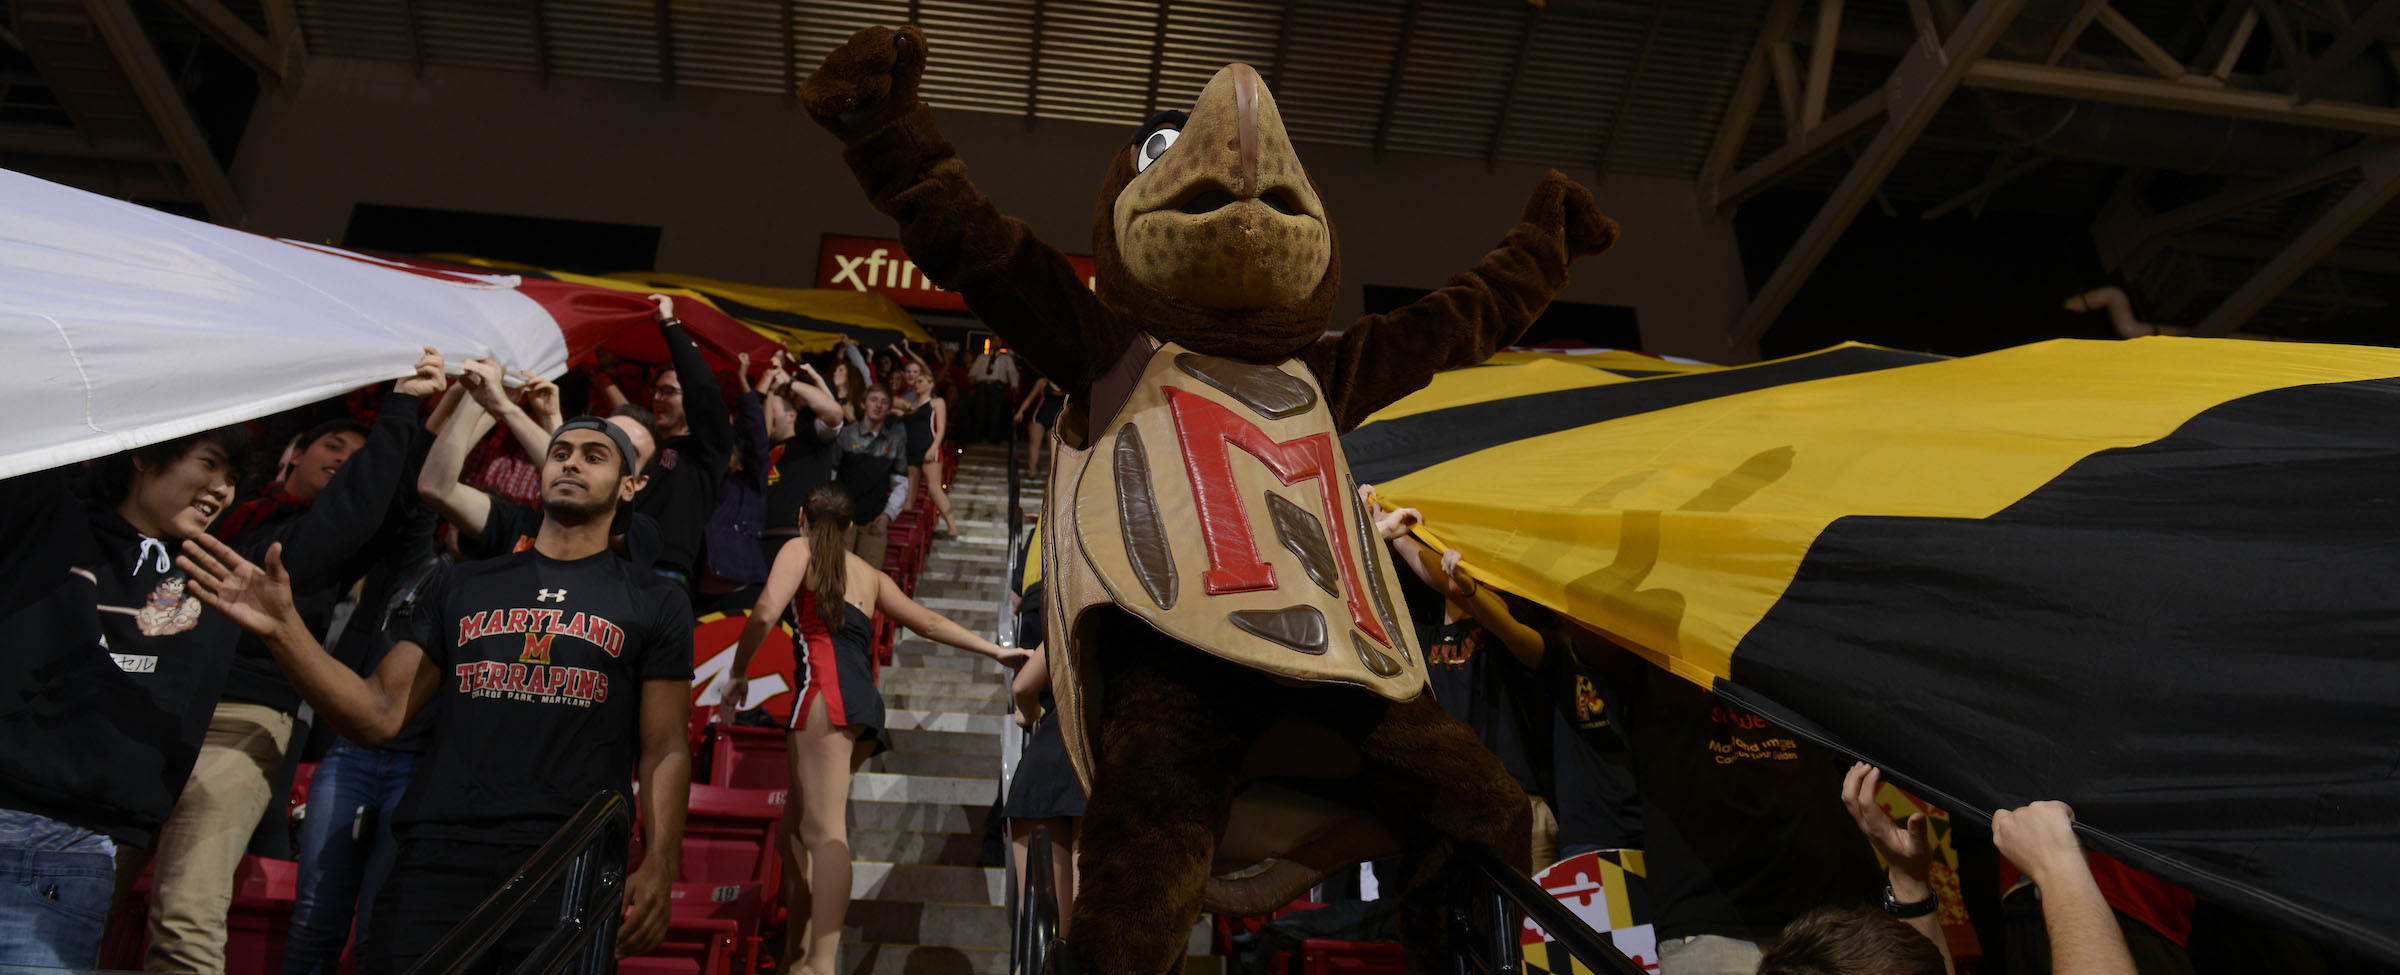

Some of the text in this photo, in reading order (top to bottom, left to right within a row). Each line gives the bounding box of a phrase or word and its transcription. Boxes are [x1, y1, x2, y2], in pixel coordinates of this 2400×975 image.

[1161, 385, 1392, 649] M
[458, 607, 626, 659] MARYLAND
[518, 632, 556, 665] M
[456, 660, 609, 703] TERRAPINS
[541, 695, 591, 709] MARYLAND
[718, 887, 735, 900] 19
